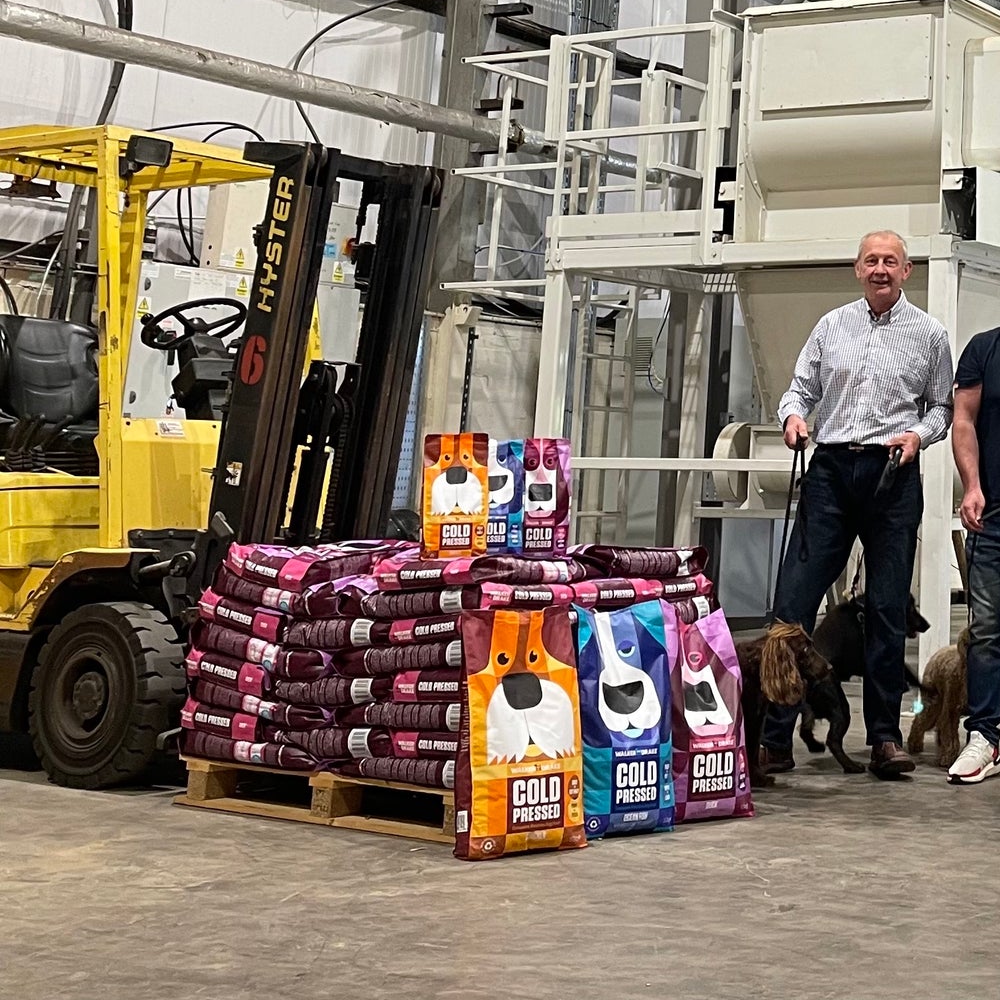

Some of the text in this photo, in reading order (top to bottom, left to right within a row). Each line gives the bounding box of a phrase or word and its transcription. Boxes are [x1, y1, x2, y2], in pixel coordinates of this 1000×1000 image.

[257, 175, 295, 313] HYSTER
[240, 335, 267, 385] 6
[442, 524, 470, 538] COLD
[487, 522, 506, 535] OLD
[525, 528, 552, 541] COLD
[442, 537, 470, 546] PRESSED
[487, 535, 506, 543] ESSED
[525, 540, 551, 548] PRESSED
[400, 570, 414, 580] COLD
[415, 569, 442, 580] PRESSED
[529, 591, 553, 601] PRESSED
[613, 589, 635, 599] PRESSED
[216, 606, 229, 618] COLD
[229, 610, 253, 626] PRESSED
[415, 625, 429, 636] COLD
[429, 621, 455, 634] PRESSED
[201, 661, 213, 671] COLD
[214, 665, 238, 680] PRESSED
[418, 681, 432, 692] COLD
[433, 682, 459, 692] PRESSED
[195, 712, 207, 722] COLD
[208, 715, 230, 728] PRESSED
[418, 739, 432, 750] COLD
[693, 751, 734, 778] COLD
[616, 760, 657, 788] COLD
[512, 776, 561, 807] COLD
[692, 775, 733, 794] PRESSED
[615, 786, 657, 805] PRESSED
[512, 803, 561, 824] PRESSED
